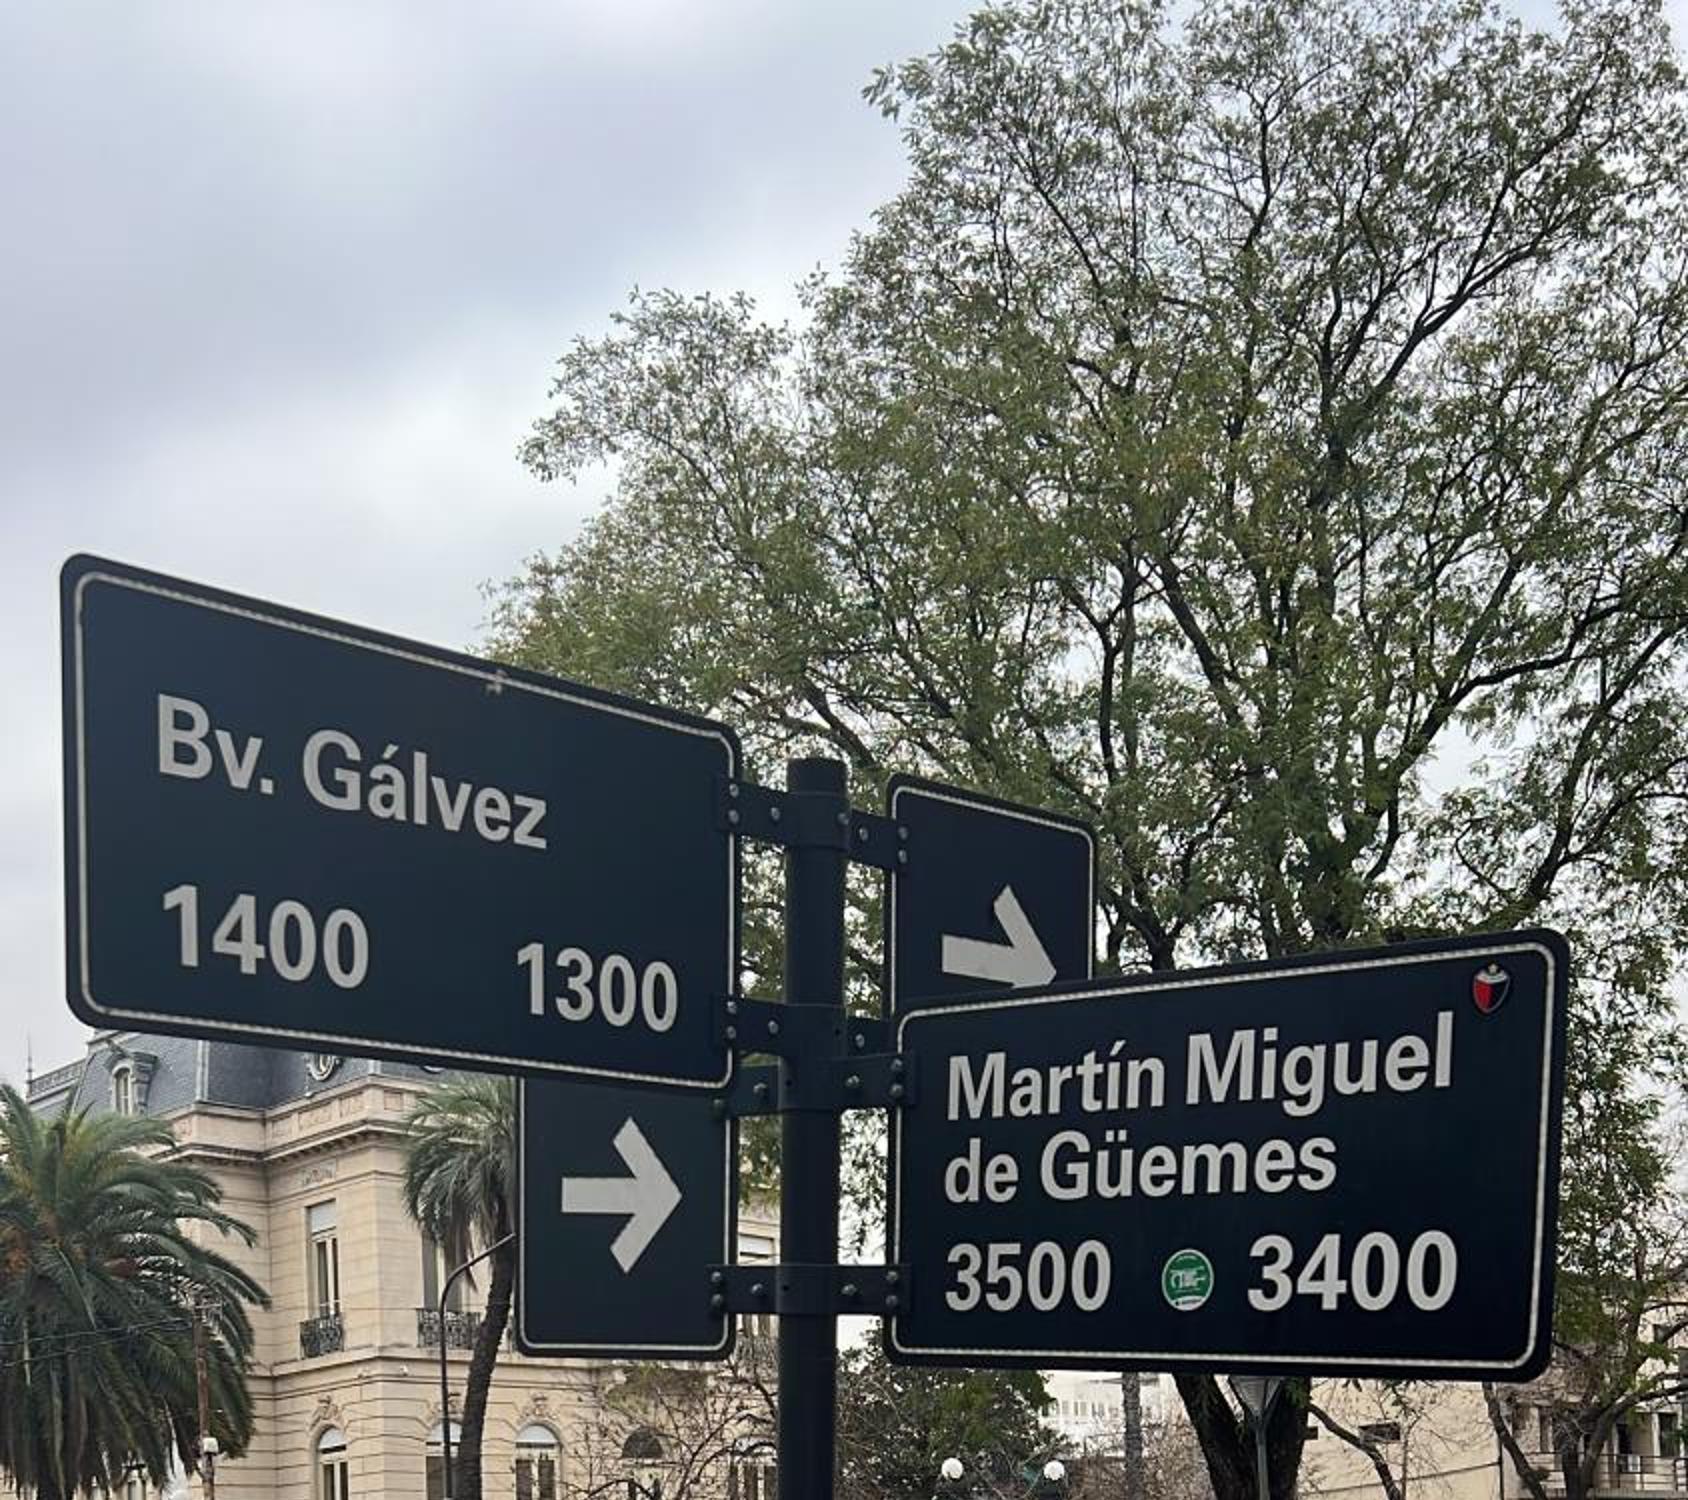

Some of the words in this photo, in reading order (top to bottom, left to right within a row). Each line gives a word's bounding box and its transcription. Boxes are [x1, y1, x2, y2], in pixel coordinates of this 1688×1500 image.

[158, 693, 274, 795] Bv.
[302, 729, 548, 849] Gálvez
[163, 884, 369, 989] 1400
[517, 942, 678, 1032] 1300
[946, 1039, 1165, 1121] Martín
[1186, 1010, 1453, 1117] Miguel
[944, 1137, 1019, 1203] de
[1040, 1129, 1337, 1200] Güemes
[944, 1239, 1111, 1311] 3500
[1247, 1230, 1457, 1311] 3400
